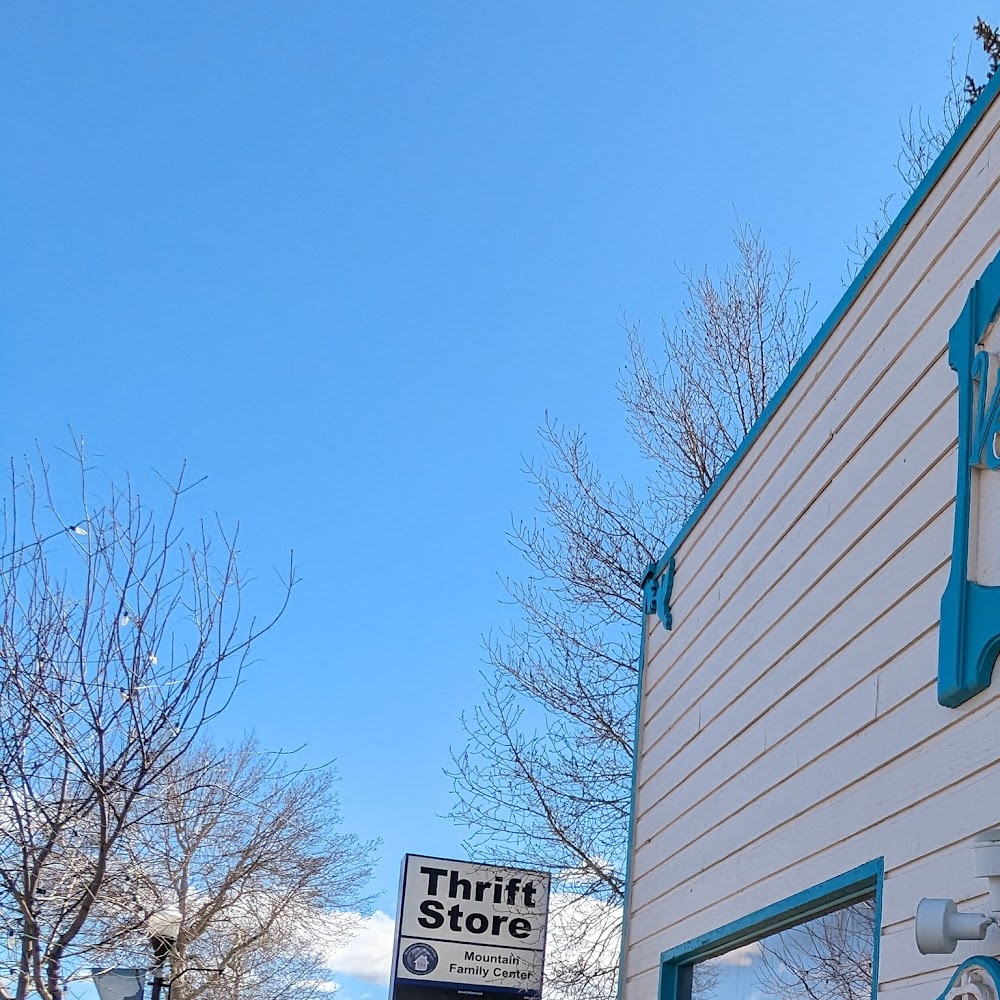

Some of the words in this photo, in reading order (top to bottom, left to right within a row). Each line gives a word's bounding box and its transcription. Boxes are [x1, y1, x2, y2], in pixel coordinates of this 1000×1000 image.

[419, 866, 537, 909] Thrift
[417, 899, 532, 939] Store
[449, 963, 490, 978] Family
[493, 966, 532, 980] Center
[464, 951, 520, 966] Mountain
